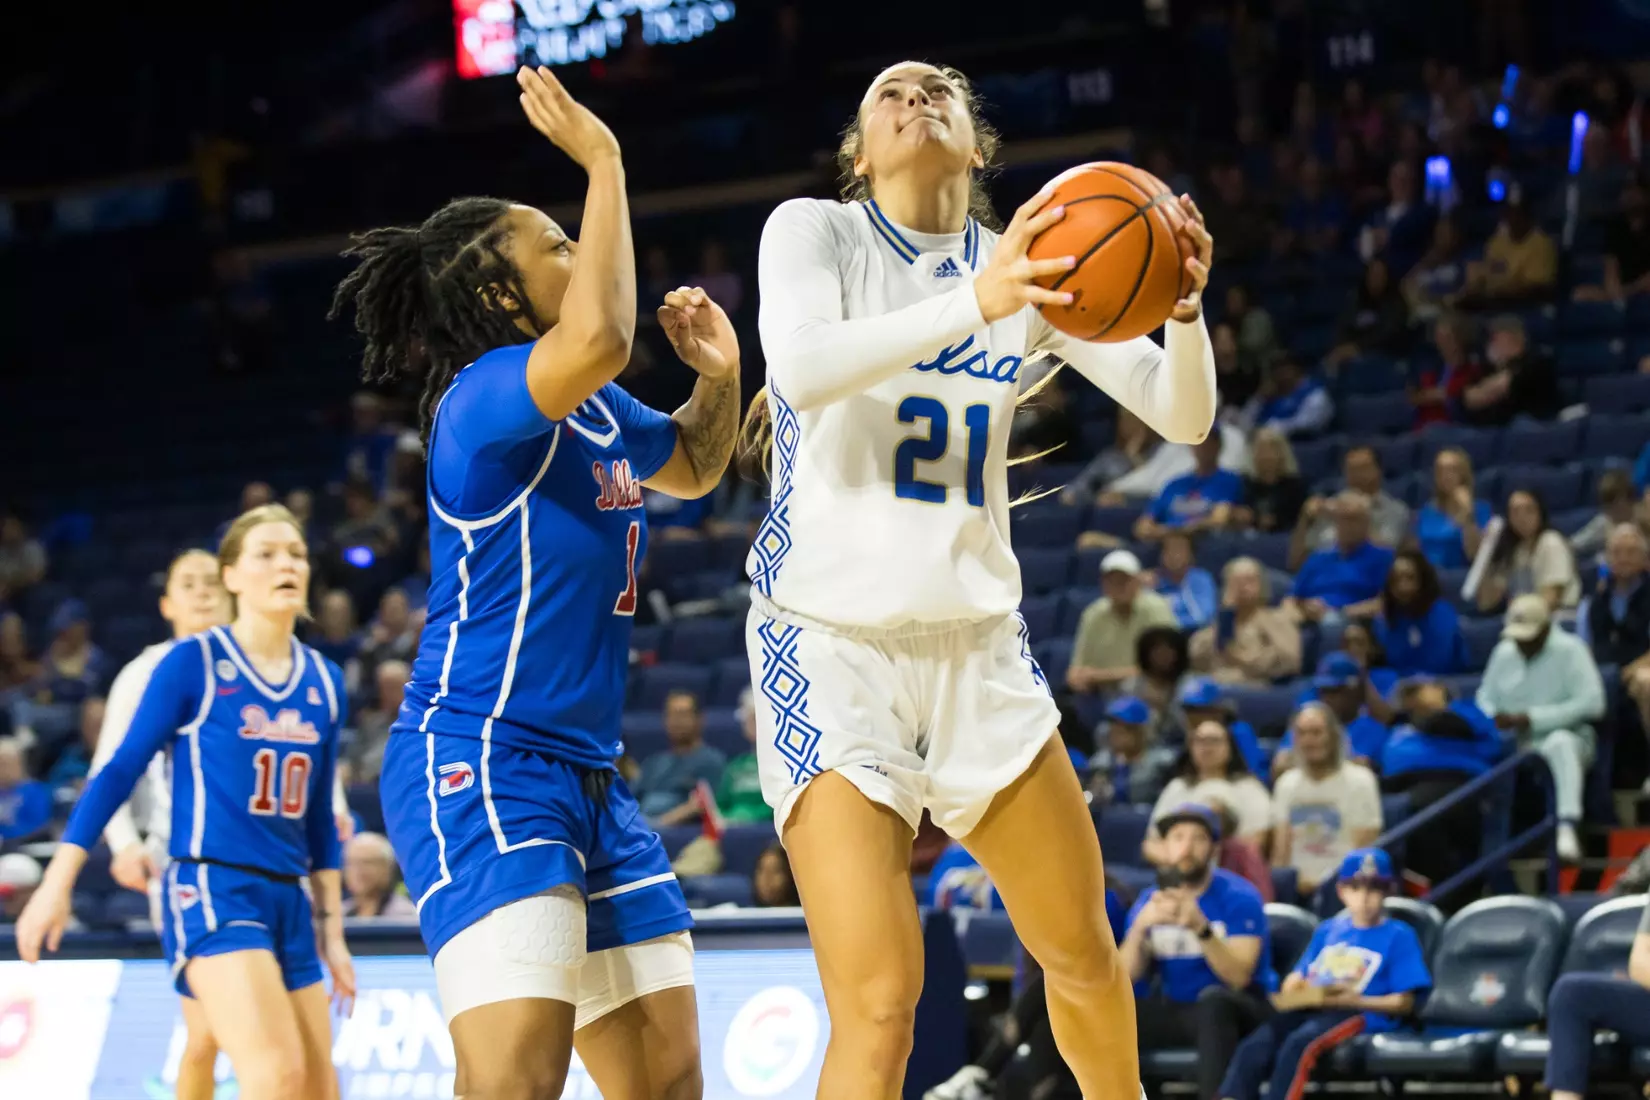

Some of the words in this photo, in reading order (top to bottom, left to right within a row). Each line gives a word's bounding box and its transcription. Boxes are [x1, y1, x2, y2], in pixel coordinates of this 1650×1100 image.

[933, 269, 963, 278] adidas
[909, 333, 1023, 384] lsa
[892, 393, 992, 508] 21
[612, 521, 640, 616] 1
[247, 748, 312, 819] 10
